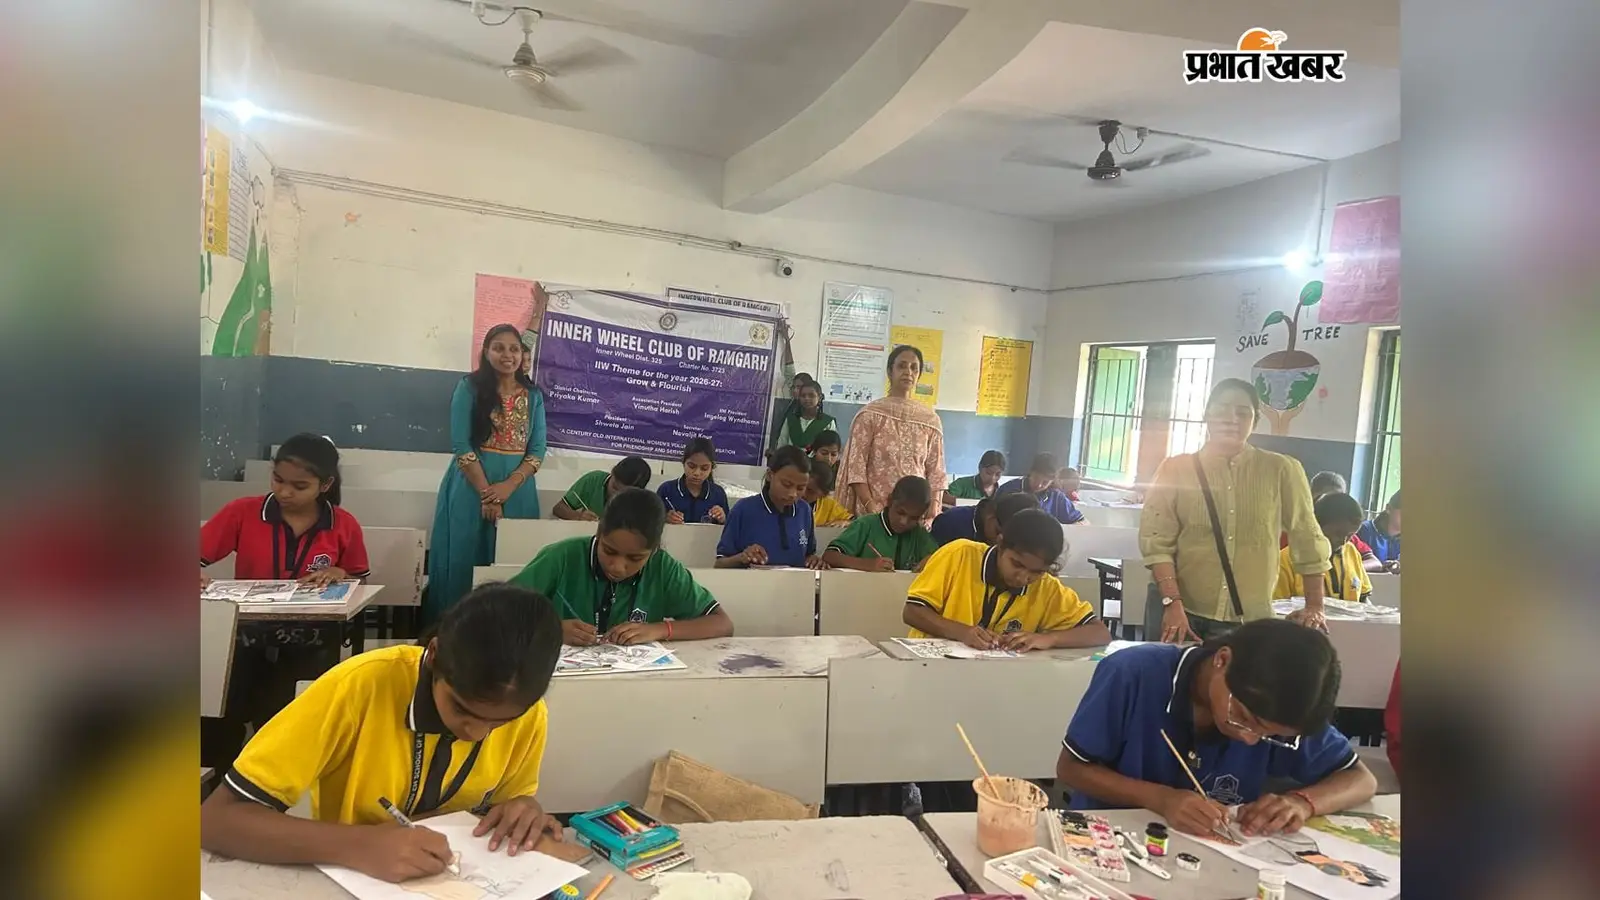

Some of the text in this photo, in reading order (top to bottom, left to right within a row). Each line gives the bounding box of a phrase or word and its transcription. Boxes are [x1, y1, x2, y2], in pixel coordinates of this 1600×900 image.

[717, 297, 732, 306] CLUB
[733, 300, 742, 308] OF
[1302, 326, 1341, 341] TREE
[547, 319, 769, 372] INNER WHEEL CLUB OF RAMGARH
[1236, 333, 1269, 353] SAVE
[595, 346, 613, 356] Inner
[614, 350, 635, 360] Wheel
[678, 361, 701, 371] Charter
[594, 360, 723, 388] IIW Theme for the year 2026-27:
[626, 376, 692, 393] Grow & Flourish
[659, 405, 681, 415] Harish
[594, 419, 635, 431] Shweta Jain
[566, 429, 592, 437] CENTURY
[604, 434, 645, 444] INTERNATIONAL
[623, 444, 654, 452] FRIENDSHIP
[666, 448, 685, 456] SERVIC
[413, 749, 422, 779] SCHOOL
